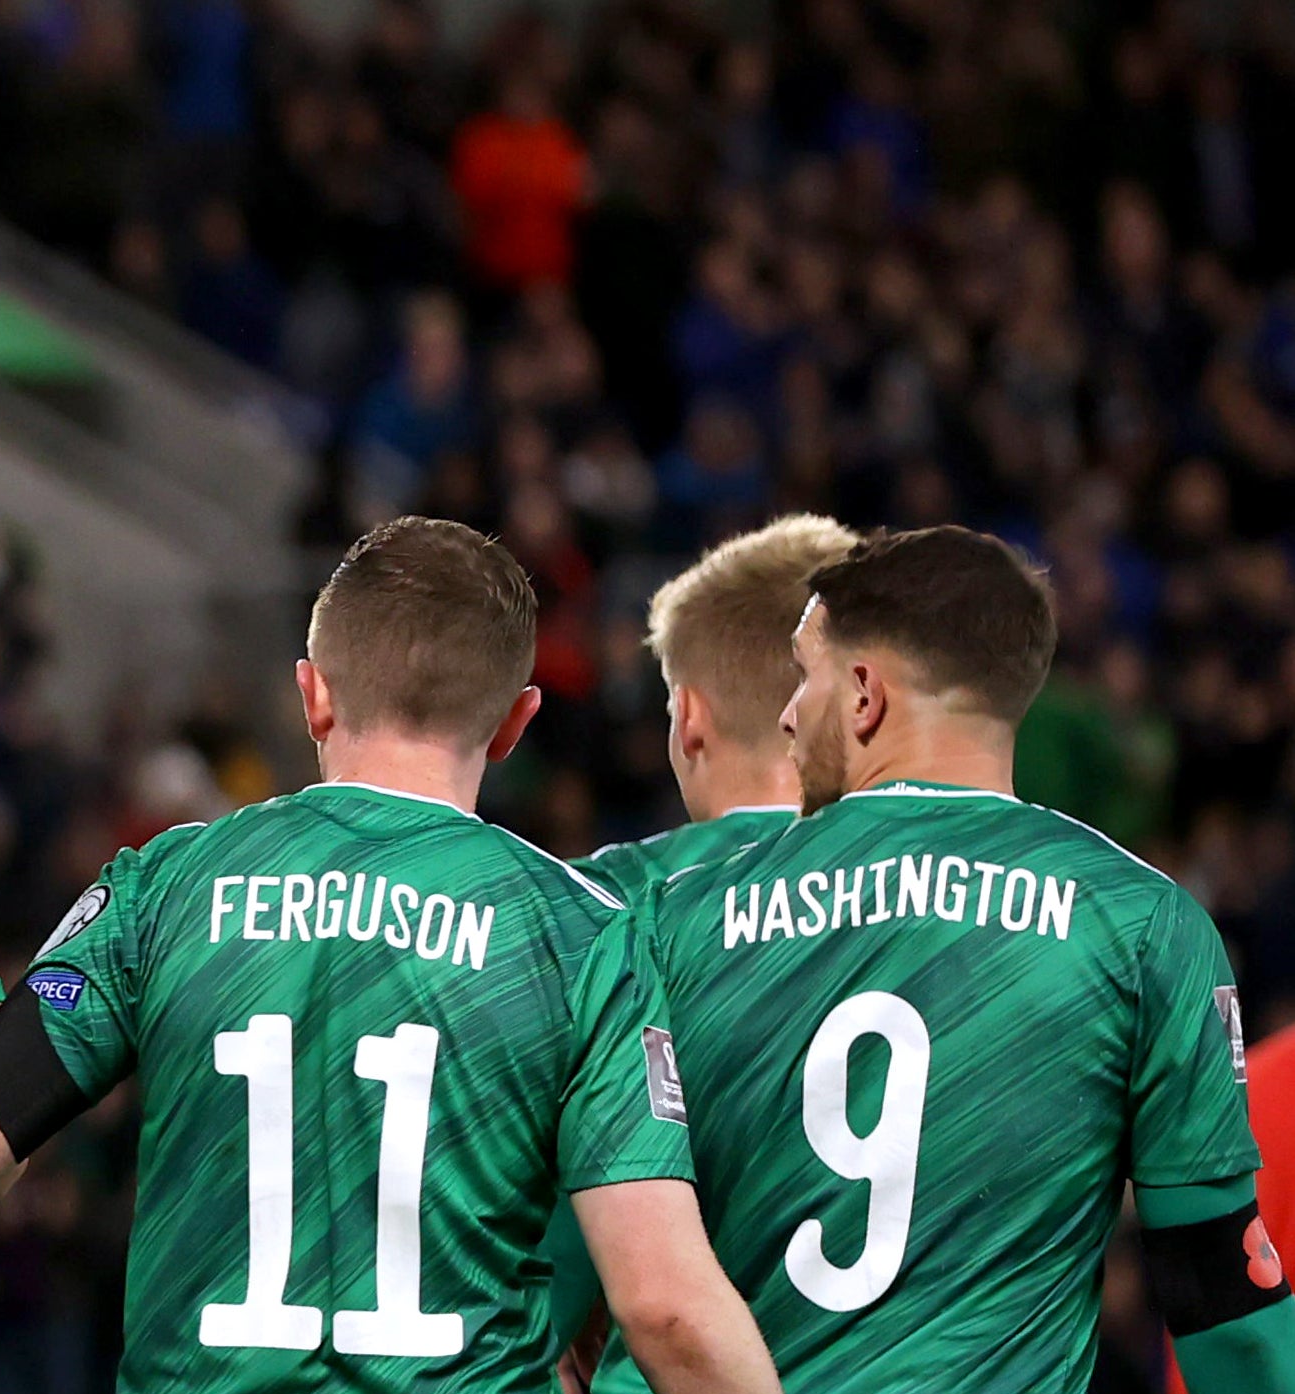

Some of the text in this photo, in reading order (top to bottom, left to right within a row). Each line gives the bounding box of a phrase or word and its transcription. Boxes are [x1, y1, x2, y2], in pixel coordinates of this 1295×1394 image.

[209, 870, 495, 971] FERGUSON
[724, 854, 1077, 950] WASHINGTON
[198, 1013, 464, 1358] 11
[784, 990, 931, 1312] 9
